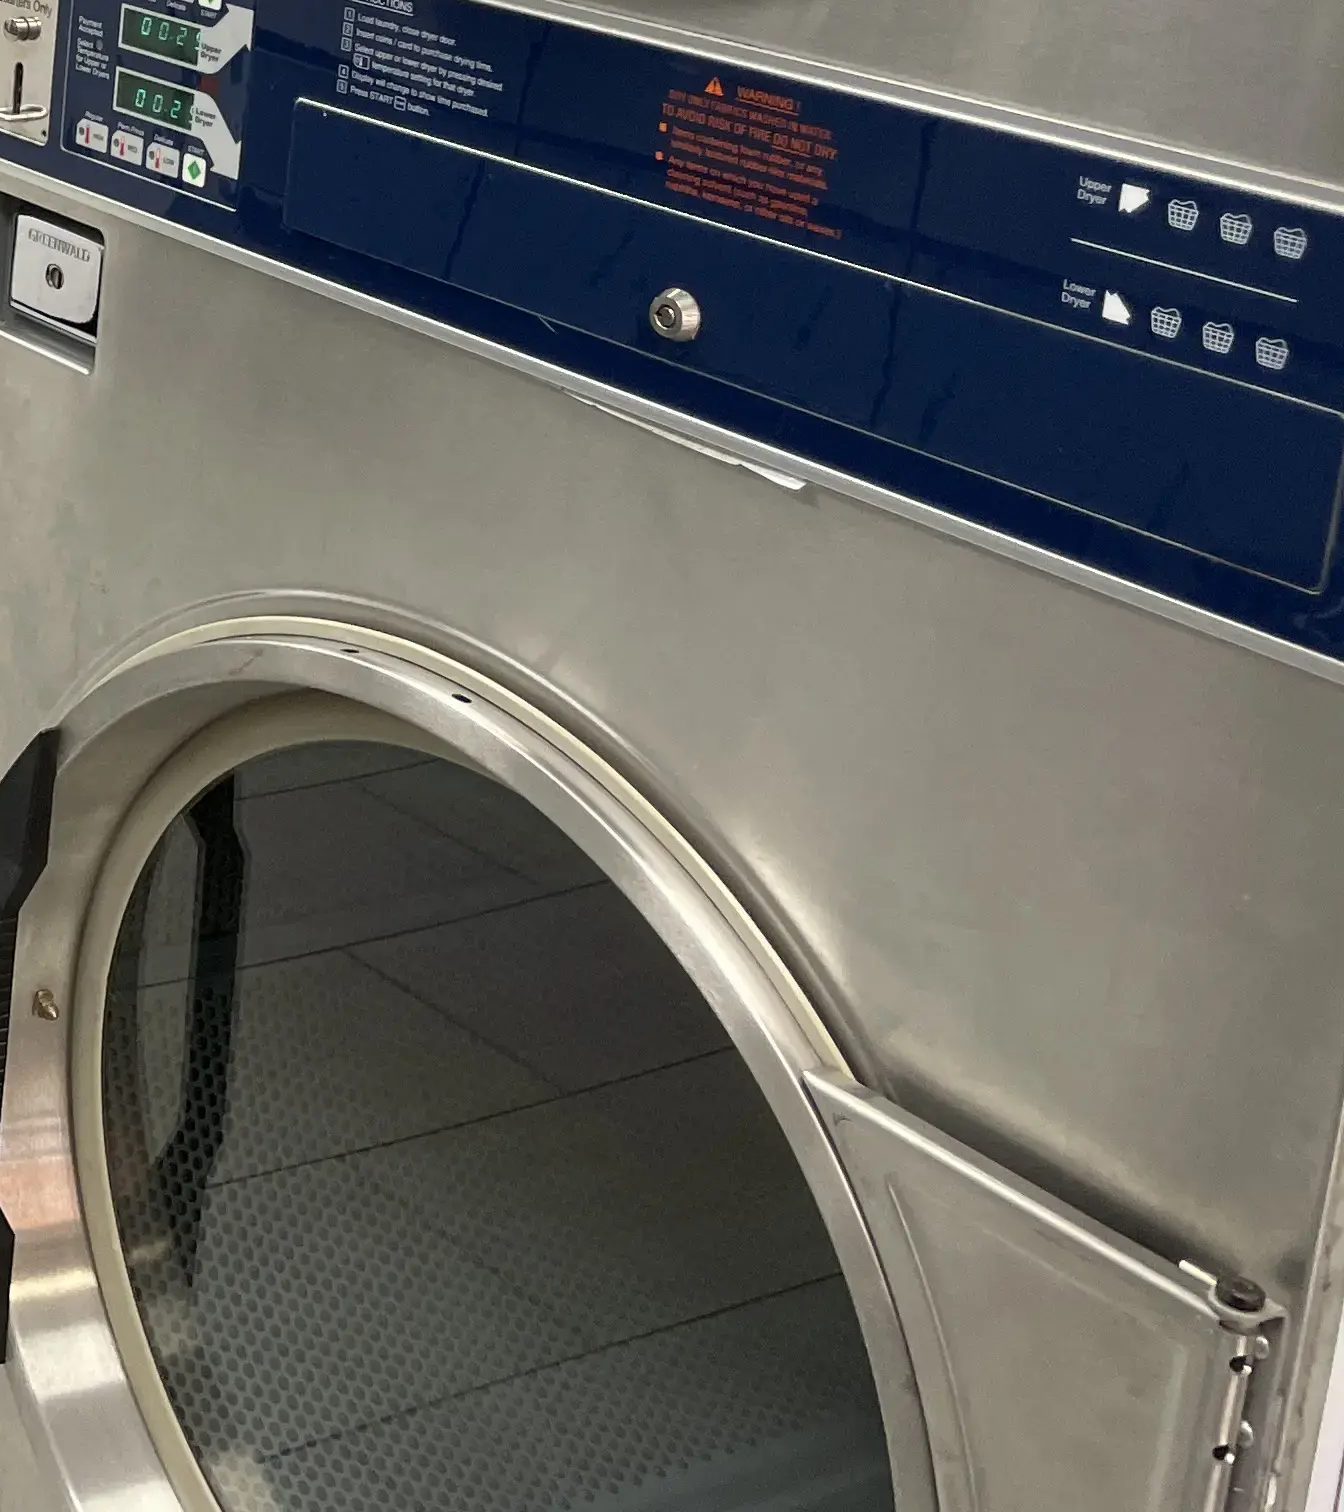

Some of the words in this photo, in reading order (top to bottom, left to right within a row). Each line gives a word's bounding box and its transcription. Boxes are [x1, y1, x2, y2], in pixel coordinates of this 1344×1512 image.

[358, 13, 374, 25] Load
[402, 26, 420, 36] close
[420, 31, 438, 42] dryer
[200, 51, 219, 62] Dryer
[201, 43, 222, 55] Upper
[356, 28, 375, 39] Insert
[375, 34, 393, 45] coins
[397, 41, 413, 50] card
[420, 47, 453, 61] purchase
[453, 55, 476, 69] drying
[355, 43, 374, 55] Select
[375, 50, 393, 61] upper
[402, 56, 420, 68] lower
[420, 62, 437, 73] dryer
[438, 67, 447, 77] by
[448, 70, 476, 85] pressing
[477, 78, 503, 92] desired
[372, 61, 409, 78] temperature
[410, 73, 432, 86] setting
[433, 77, 442, 87] for
[442, 81, 456, 92] that
[350, 85, 369, 98] Press
[369, 91, 393, 105] START
[352, 70, 374, 86] Display
[375, 78, 386, 87] will
[386, 82, 410, 96] change
[419, 90, 436, 102] show
[437, 94, 451, 106] time
[737, 86, 794, 110] WARNING
[194, 116, 214, 128] Dryer
[195, 107, 216, 120] Lower
[662, 103, 674, 116] TO
[675, 107, 706, 124] AVOID
[708, 115, 731, 132] RISK
[733, 122, 748, 135] OF
[749, 126, 772, 142] FIRE
[773, 133, 788, 148] DO
[791, 137, 812, 153] NOT
[1079, 176, 1112, 193] Upper
[1077, 189, 1107, 205] Dryer
[28, 228, 91, 263] GREENWALD
[1063, 279, 1096, 297] Lower
[1061, 291, 1091, 309] Dryer
